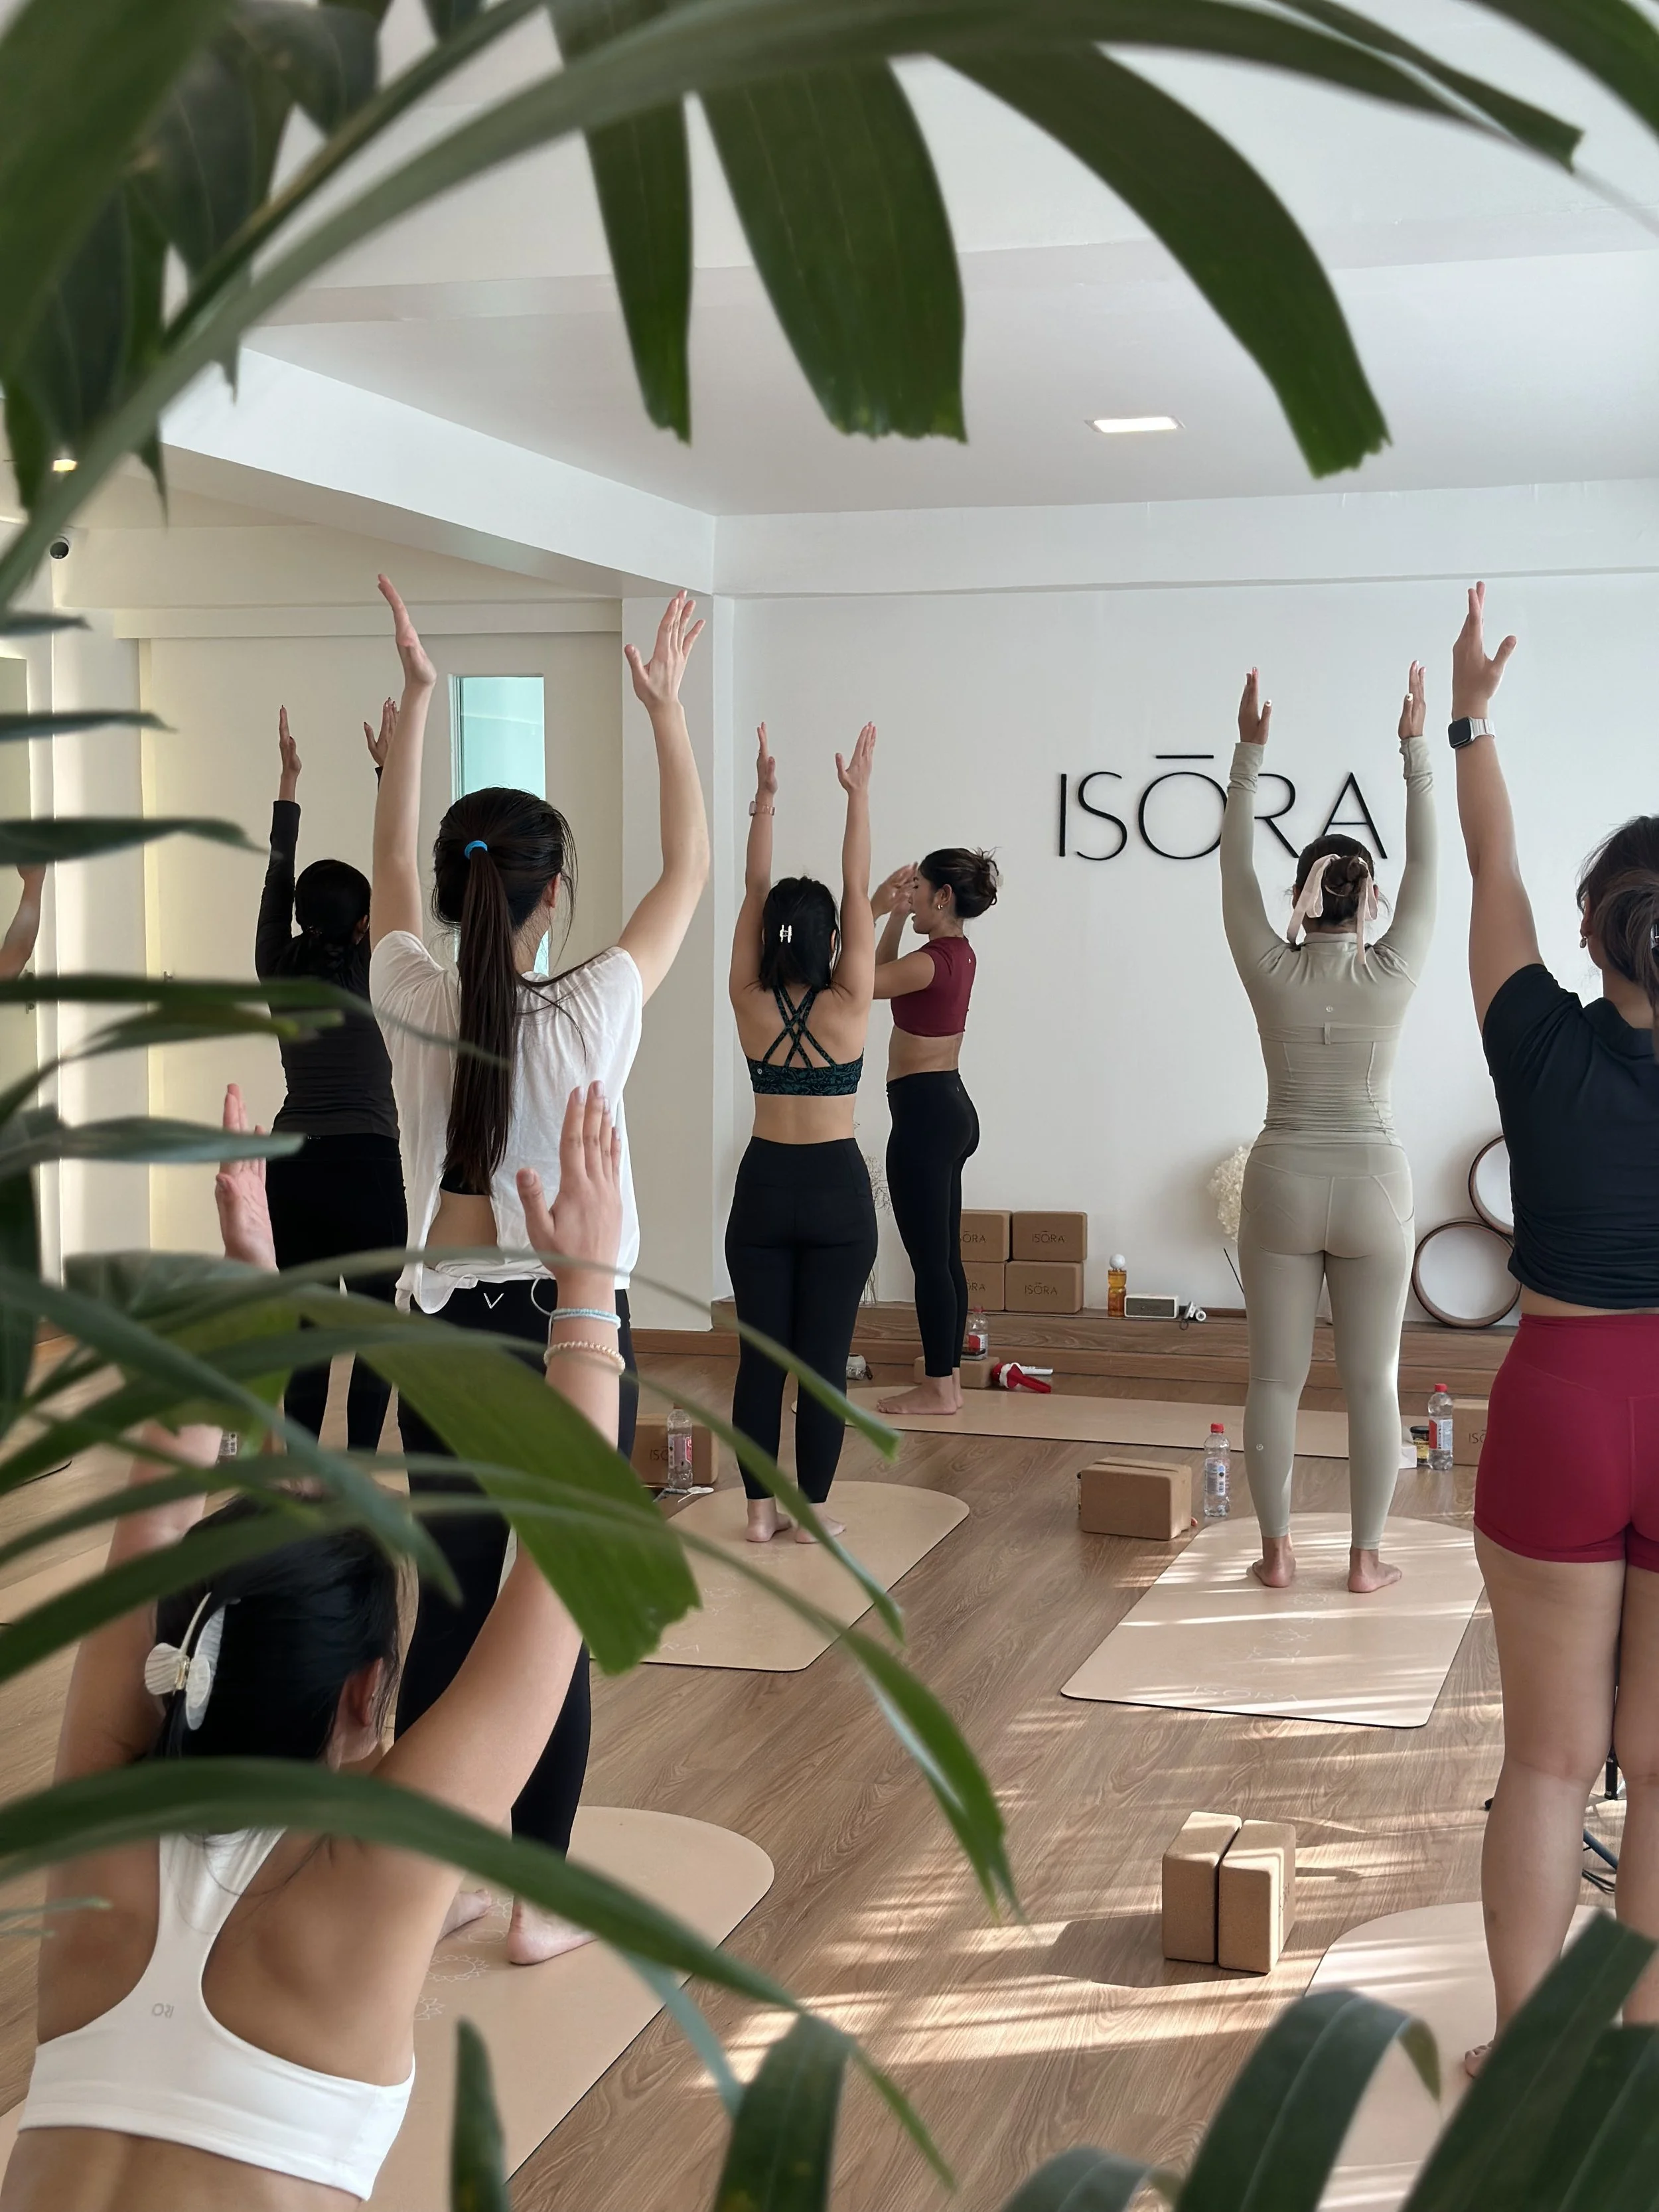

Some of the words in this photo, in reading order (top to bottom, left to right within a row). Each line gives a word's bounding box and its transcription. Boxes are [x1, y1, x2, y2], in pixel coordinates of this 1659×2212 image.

[1058, 754, 1388, 861] ISŌRA
[960, 1230, 987, 1243] ŌRA
[1031, 1230, 1065, 1243] ISŌRA
[1024, 1282, 1057, 1295] ISŌRA
[1469, 1430, 1487, 1444] ISŌ
[650, 1445, 668, 1461] ISŌ
